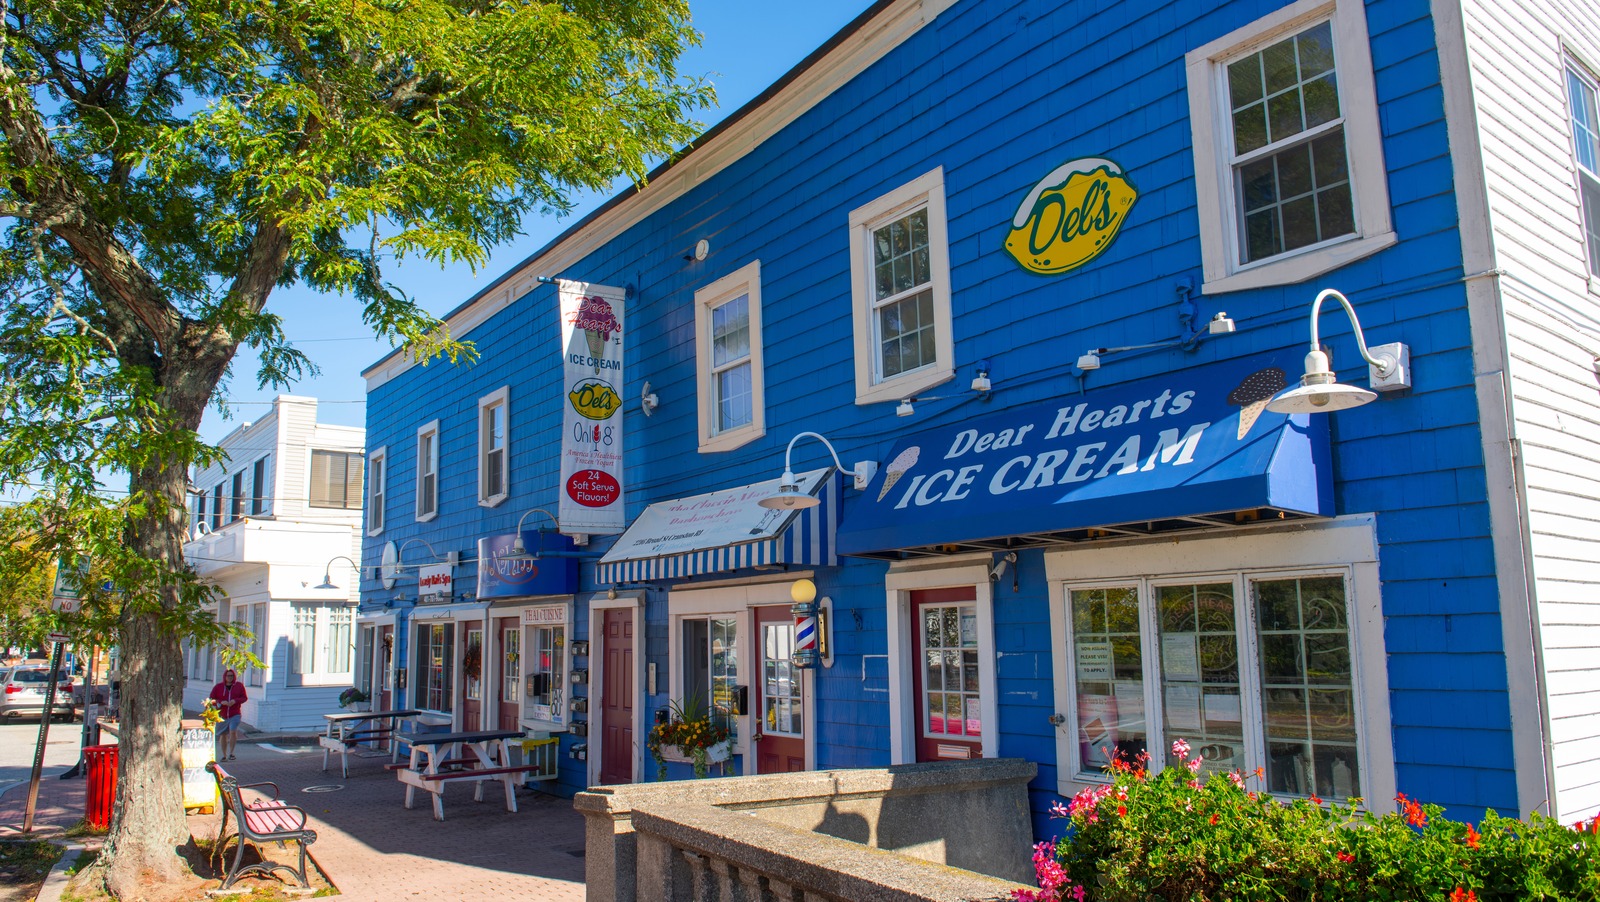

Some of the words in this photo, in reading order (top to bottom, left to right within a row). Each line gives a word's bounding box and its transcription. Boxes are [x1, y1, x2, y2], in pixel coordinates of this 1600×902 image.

[1028, 179, 1118, 256] Del's
[575, 296, 613, 315] Dear
[569, 353, 585, 366] ICE
[586, 357, 621, 371] CREAM
[943, 422, 1034, 460] Dear
[1044, 389, 1196, 440] Hearts
[602, 426, 613, 446] 8
[596, 459, 615, 468] Yogurt
[894, 463, 983, 510] ICE
[988, 422, 1210, 496] CREAM
[588, 470, 600, 480] 24
[572, 480, 589, 491] Soft
[591, 482, 615, 492] Serve
[576, 491, 610, 503] Flavors!
[441, 573, 451, 587] Spa
[61, 601, 73, 611] NO
[524, 609, 539, 621] THAI
[539, 607, 564, 621] CUISINE
